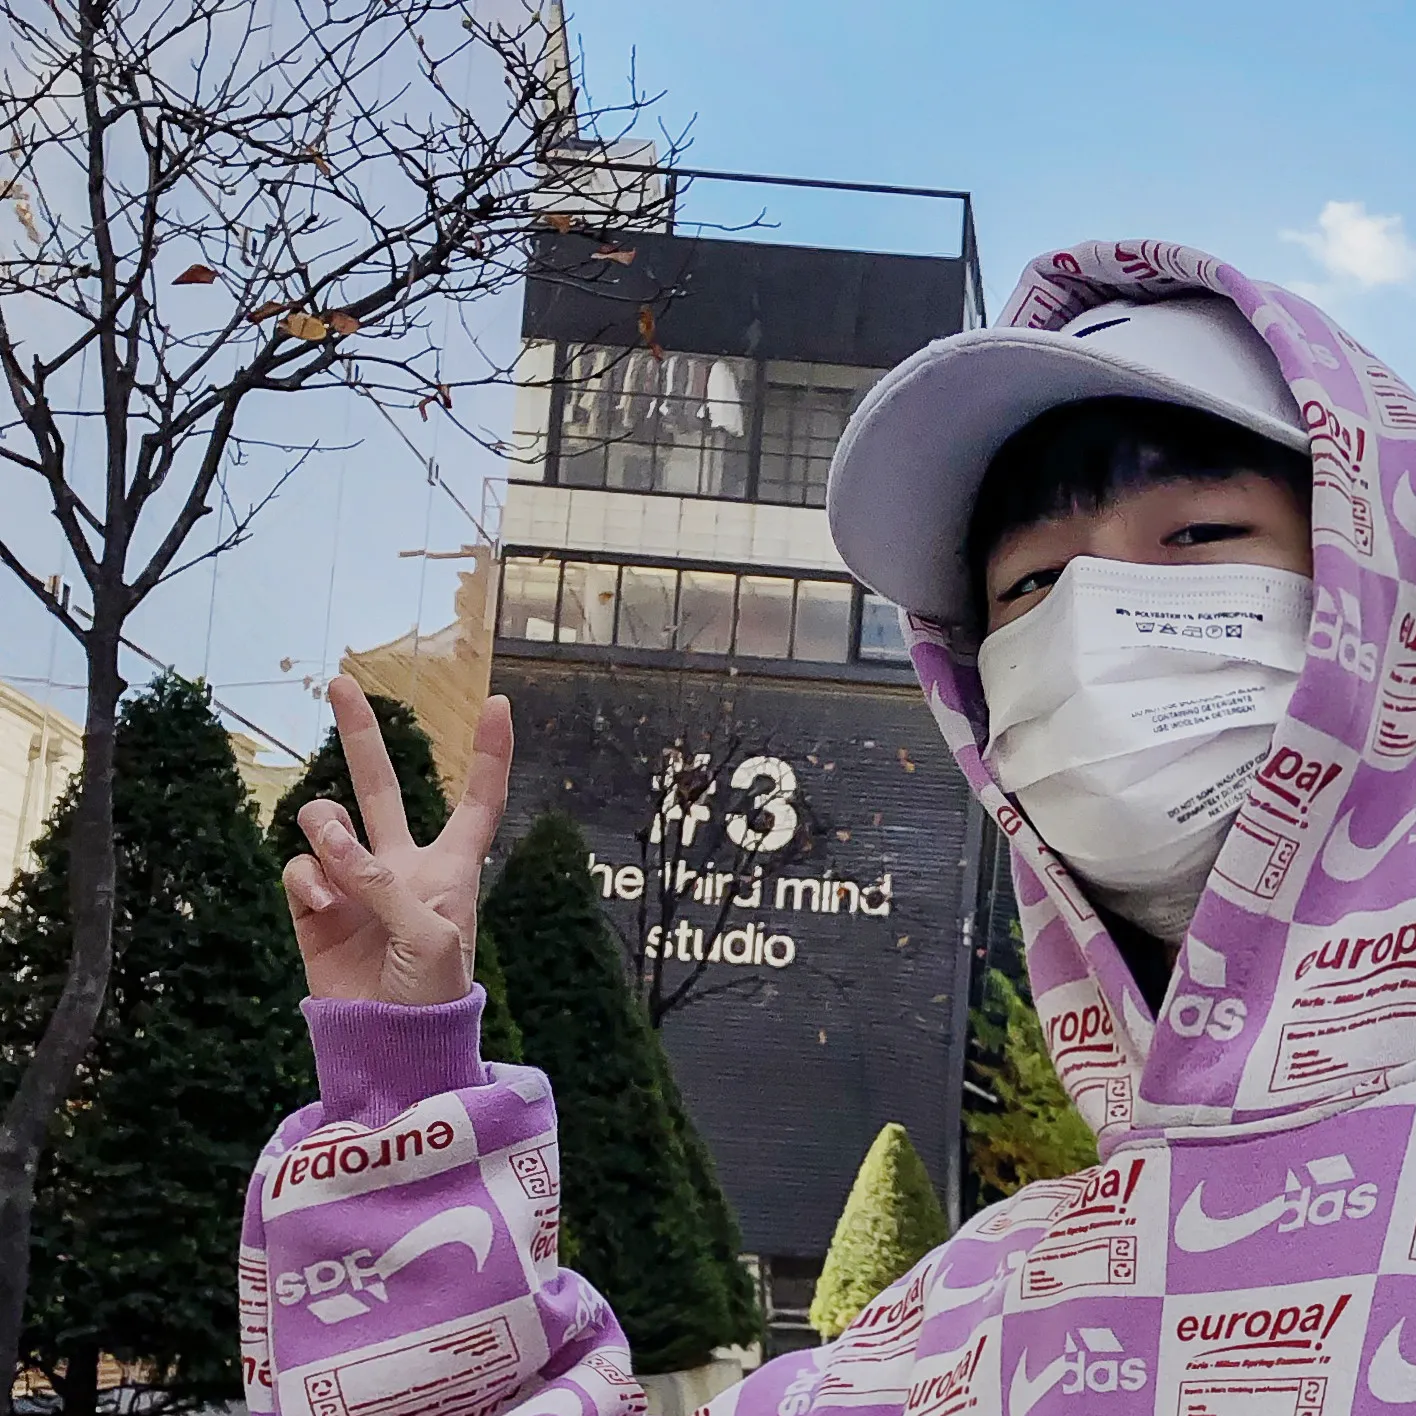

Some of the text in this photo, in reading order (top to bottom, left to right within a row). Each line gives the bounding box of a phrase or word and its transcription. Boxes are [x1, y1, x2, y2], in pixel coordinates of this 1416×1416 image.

[588, 853, 644, 900] he
[775, 872, 892, 917] mind
[645, 920, 795, 968] studio
[272, 1120, 454, 1200] europa!
[1277, 1181, 1379, 1233] das
[1176, 1294, 1352, 1351] europa!
[1062, 1351, 1147, 1396] das
